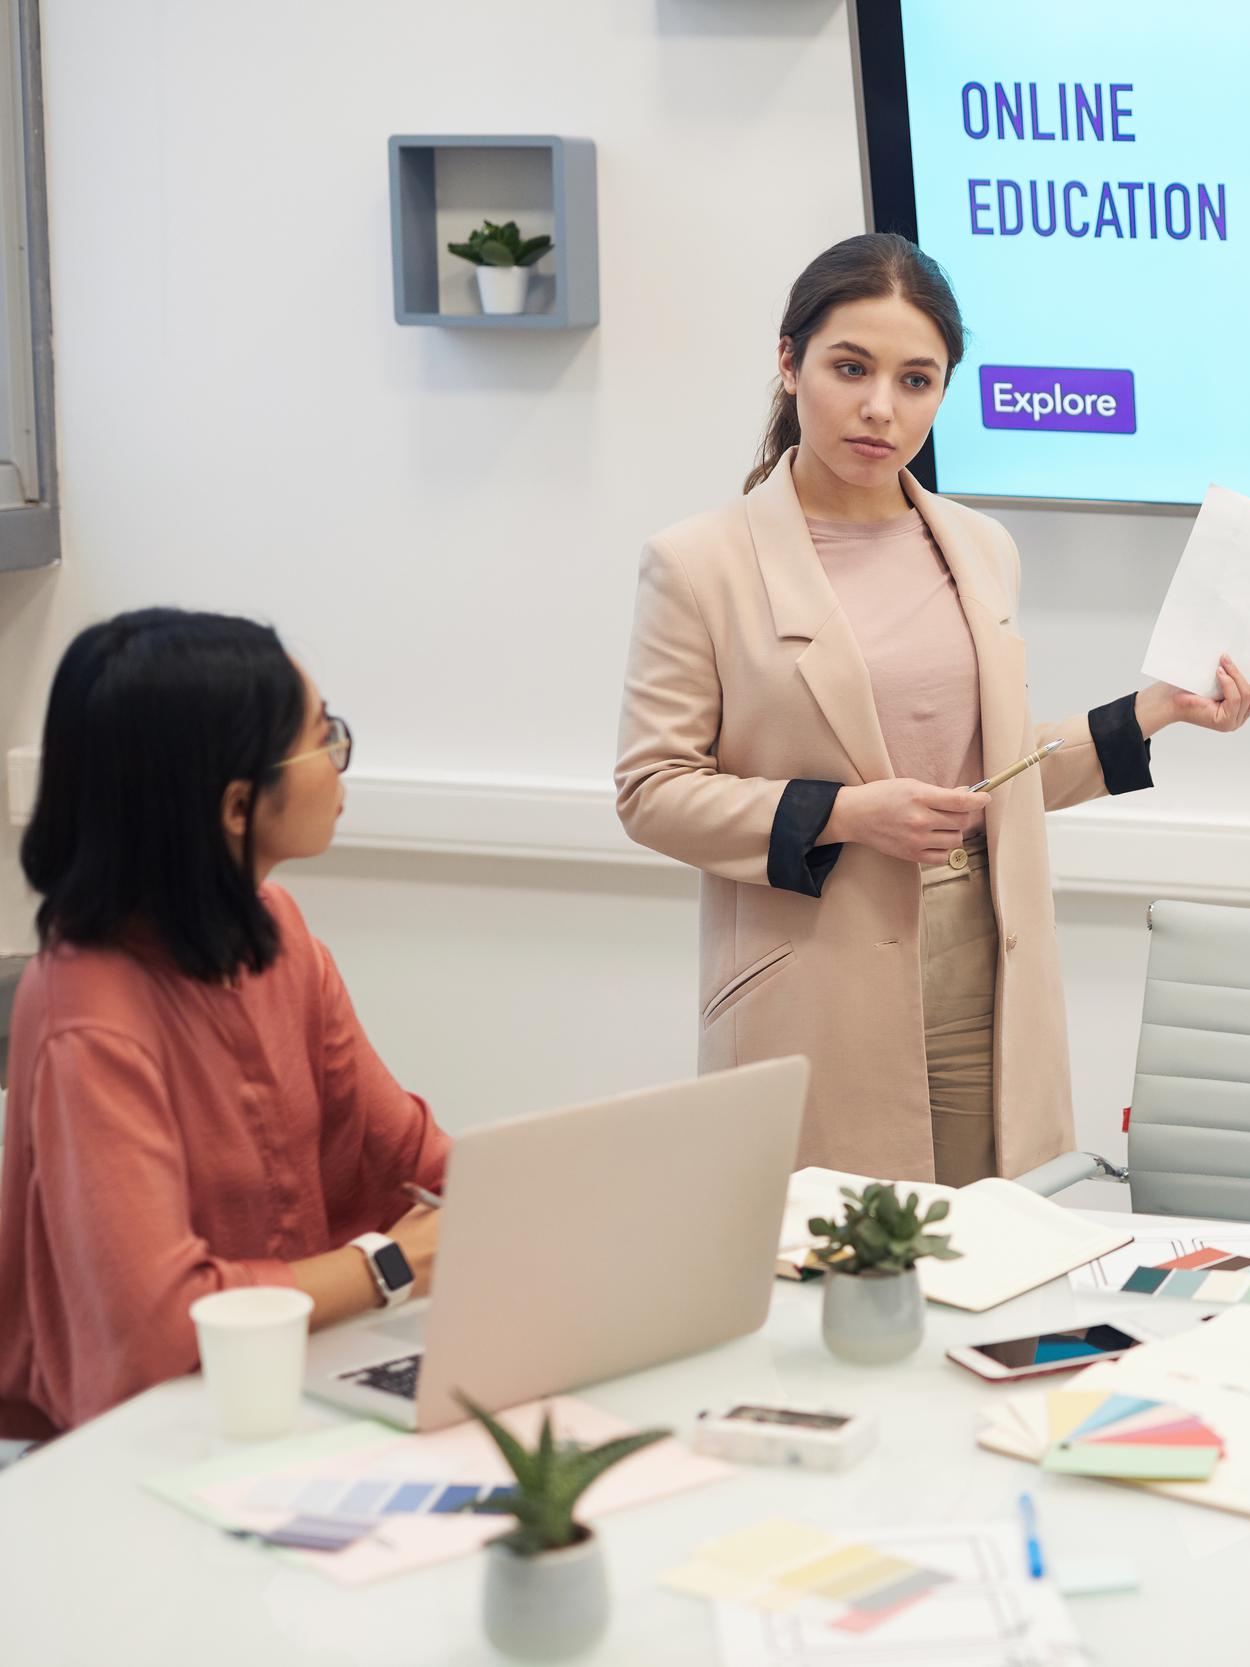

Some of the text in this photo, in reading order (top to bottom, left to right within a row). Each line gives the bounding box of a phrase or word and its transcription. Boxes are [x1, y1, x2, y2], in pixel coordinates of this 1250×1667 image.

[961, 81, 1136, 142] ONLINE
[968, 178, 1227, 241] EDUCATION
[993, 382, 1117, 421] Explore
